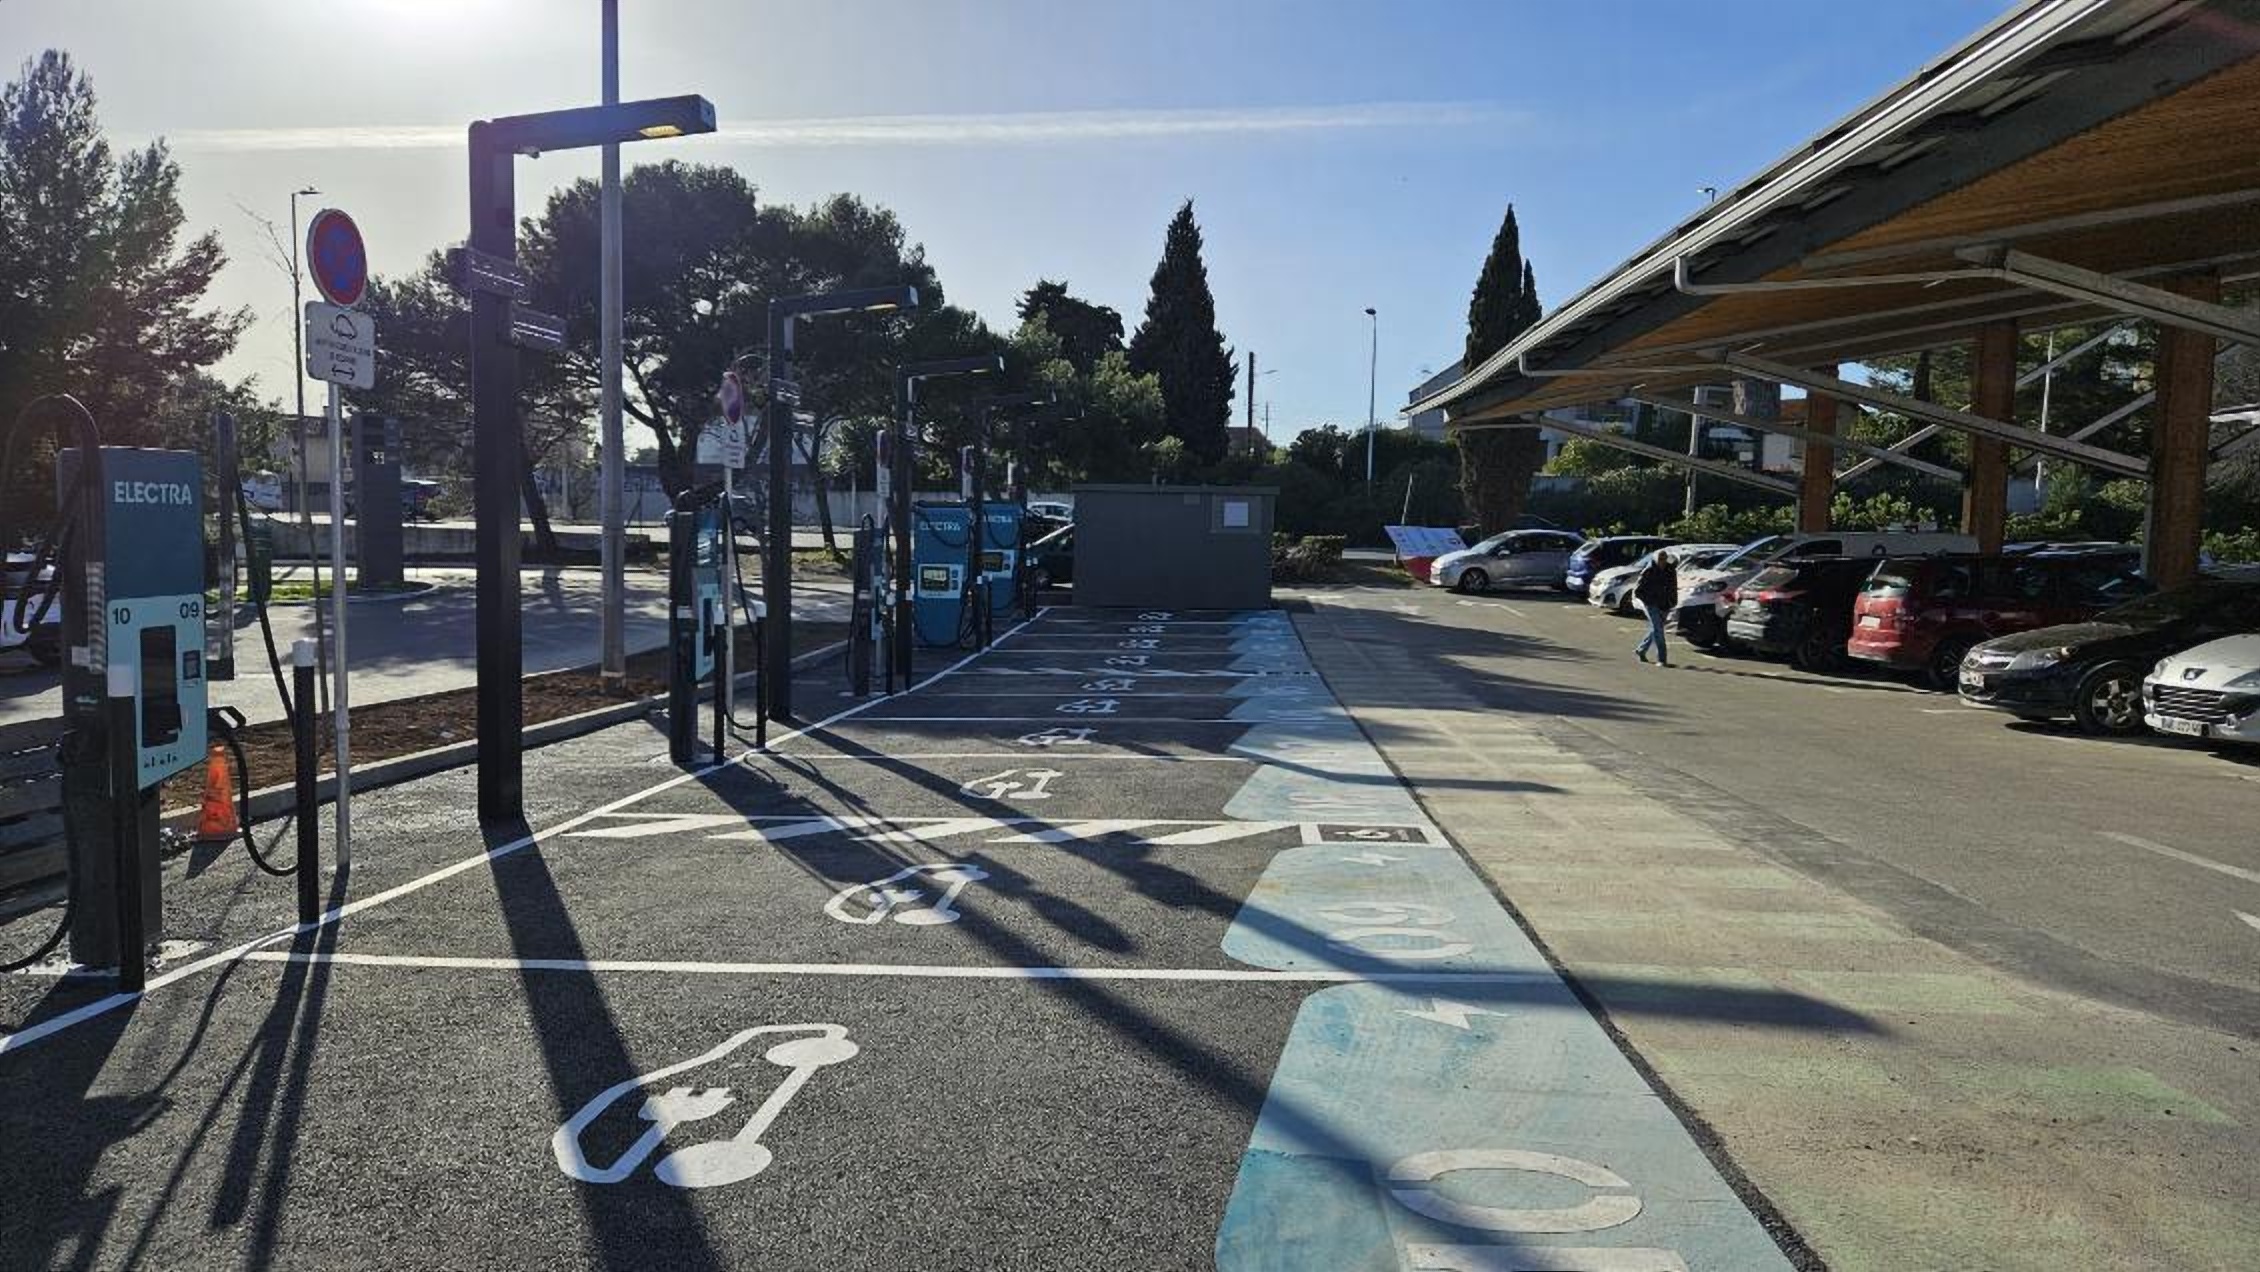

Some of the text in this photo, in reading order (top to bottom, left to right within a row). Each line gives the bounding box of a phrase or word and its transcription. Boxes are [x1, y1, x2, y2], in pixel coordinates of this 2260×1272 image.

[114, 480, 193, 504] ELECTRA
[111, 607, 131, 625] 10
[179, 602, 200, 619] 09
[1316, 902, 1473, 959] 09
